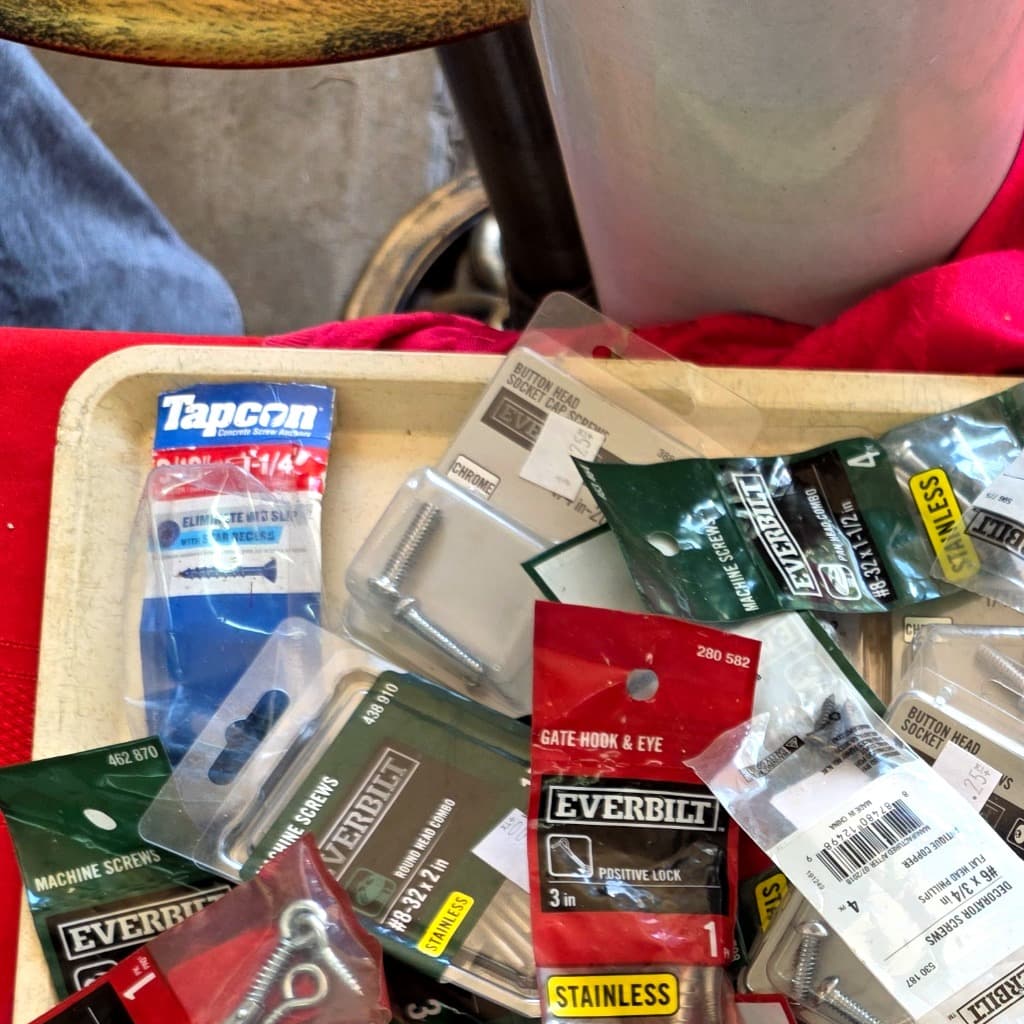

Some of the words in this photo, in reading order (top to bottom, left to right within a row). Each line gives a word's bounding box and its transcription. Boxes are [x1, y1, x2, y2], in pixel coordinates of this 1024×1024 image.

[513, 362, 553, 391] BUTTON
[553, 386, 580, 410] HEAD
[162, 394, 318, 437] Tapcon
[217, 429, 249, 437] Concrete
[253, 428, 277, 436] Screw
[452, 462, 496, 494] CHROME
[707, 519, 733, 560] SCREWS
[740, 479, 811, 590] EVERBILT
[919, 475, 968, 574] STAINLESS
[724, 561, 759, 612] MACHINE
[696, 645, 722, 661] 280
[725, 652, 751, 669] 582
[361, 703, 385, 726] 438
[378, 683, 399, 704] 910
[540, 729, 577, 747] GATE
[580, 731, 618, 749] HOOK
[622, 735, 633, 751] &
[638, 736, 664, 753] EYE
[900, 718, 945, 749] SOCKET
[907, 706, 951, 739] BUTTON
[950, 727, 981, 755] HEAD
[108, 752, 131, 767] 462
[135, 745, 159, 761] 870
[900, 789, 908, 798] 8
[555, 793, 712, 825] EVERBILT
[857, 799, 892, 827] 87480
[394, 843, 420, 879] ROUND
[415, 821, 438, 849] HEAD
[430, 798, 456, 828] COMBO
[821, 823, 857, 852] 12498
[886, 823, 930, 855] MANUFACTURED
[35, 862, 101, 892] MACHINE
[105, 850, 161, 876] SCREWS
[804, 854, 812, 863] 9
[867, 851, 888, 868] AFTER
[948, 864, 969, 882] HEAD
[966, 853, 985, 870] FLAT
[599, 867, 650, 881] POSITIVE
[652, 869, 682, 882] LOCK
[844, 864, 870, 885] 07/2018
[550, 888, 561, 908] 3
[563, 893, 576, 907] in
[916, 877, 951, 904] PHILLIPS
[959, 879, 1012, 920] DECORATOR
[425, 895, 469, 952] STAINLESS
[923, 914, 964, 947] SCREWS
[703, 921, 718, 958] 1
[904, 972, 921, 987] 187
[918, 960, 936, 976] 530
[123, 971, 157, 1001] 1
[555, 983, 671, 1008] STAINLESS
